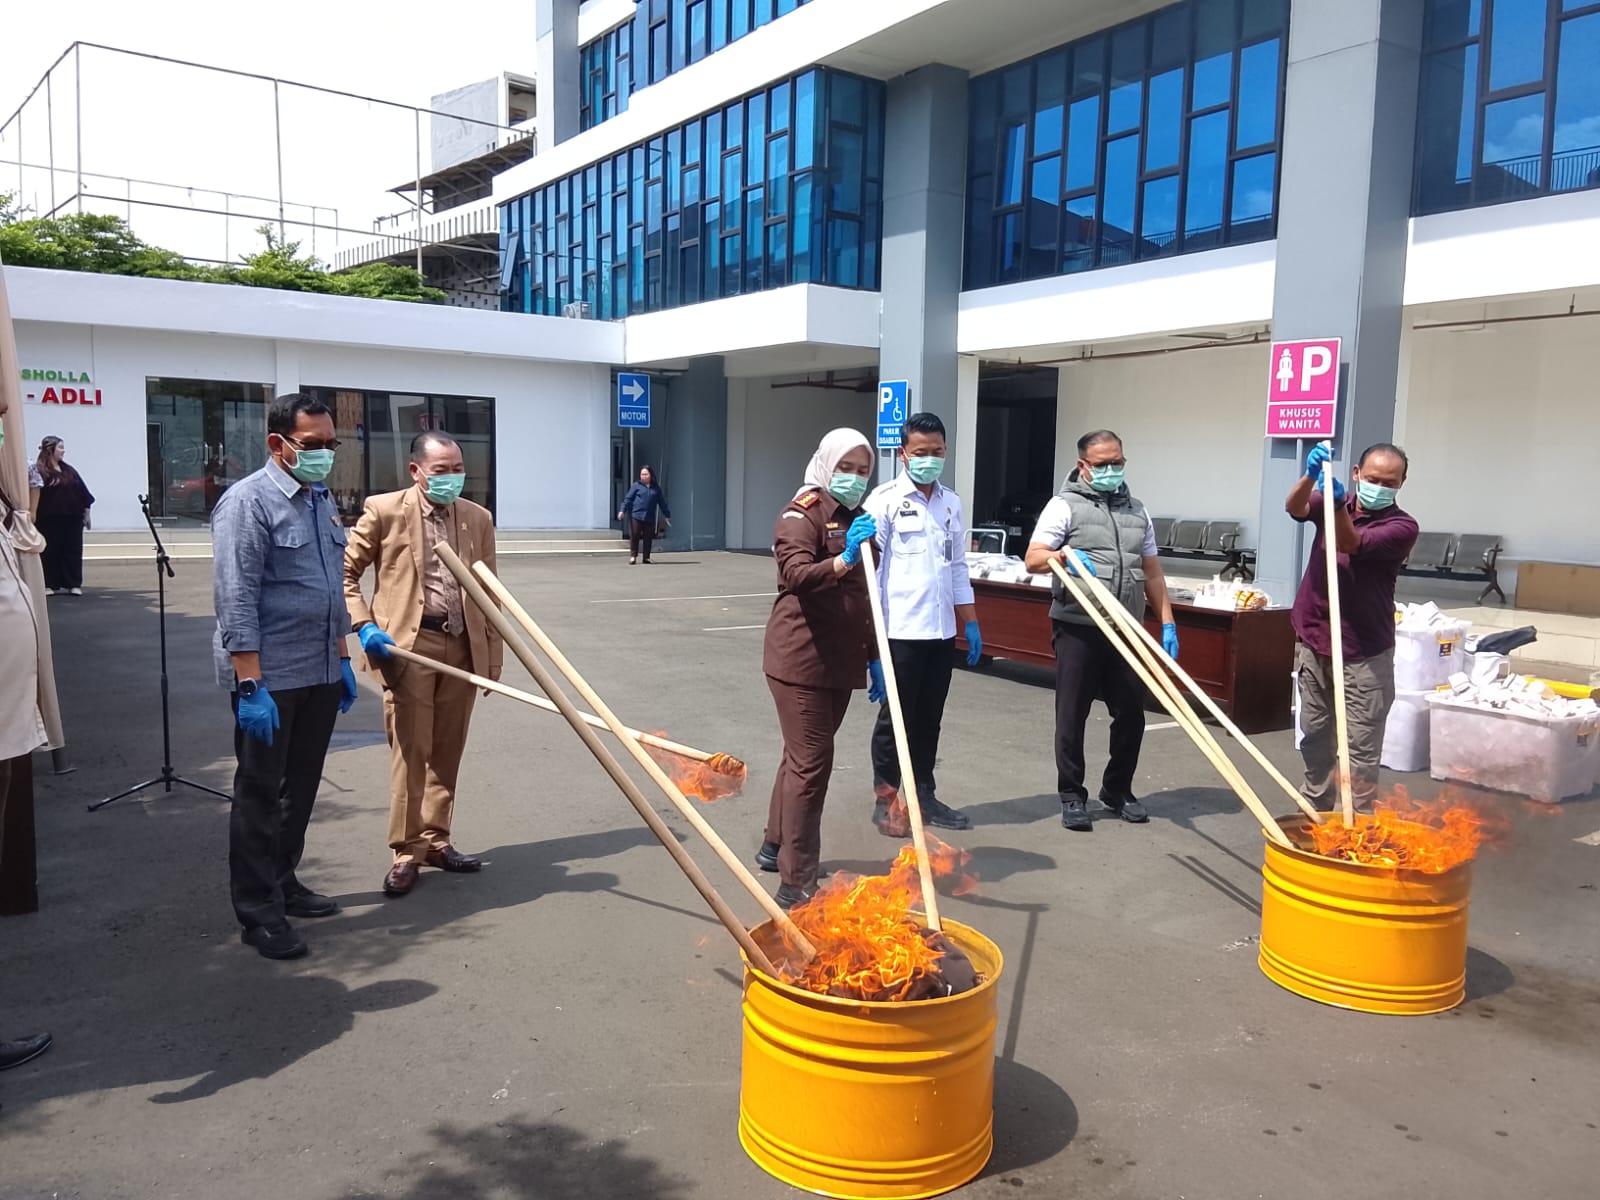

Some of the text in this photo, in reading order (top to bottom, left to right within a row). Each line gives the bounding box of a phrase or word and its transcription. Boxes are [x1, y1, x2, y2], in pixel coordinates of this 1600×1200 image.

[20, 368, 91, 383] SHOLLA
[1301, 346, 1332, 392] P
[41, 387, 102, 405] ADLI
[880, 387, 892, 413] P
[621, 411, 647, 422] MOTOR
[1279, 408, 1321, 418] KHUSUS
[1279, 419, 1321, 429] WANITA
[879, 436, 902, 444] DISABILITA
